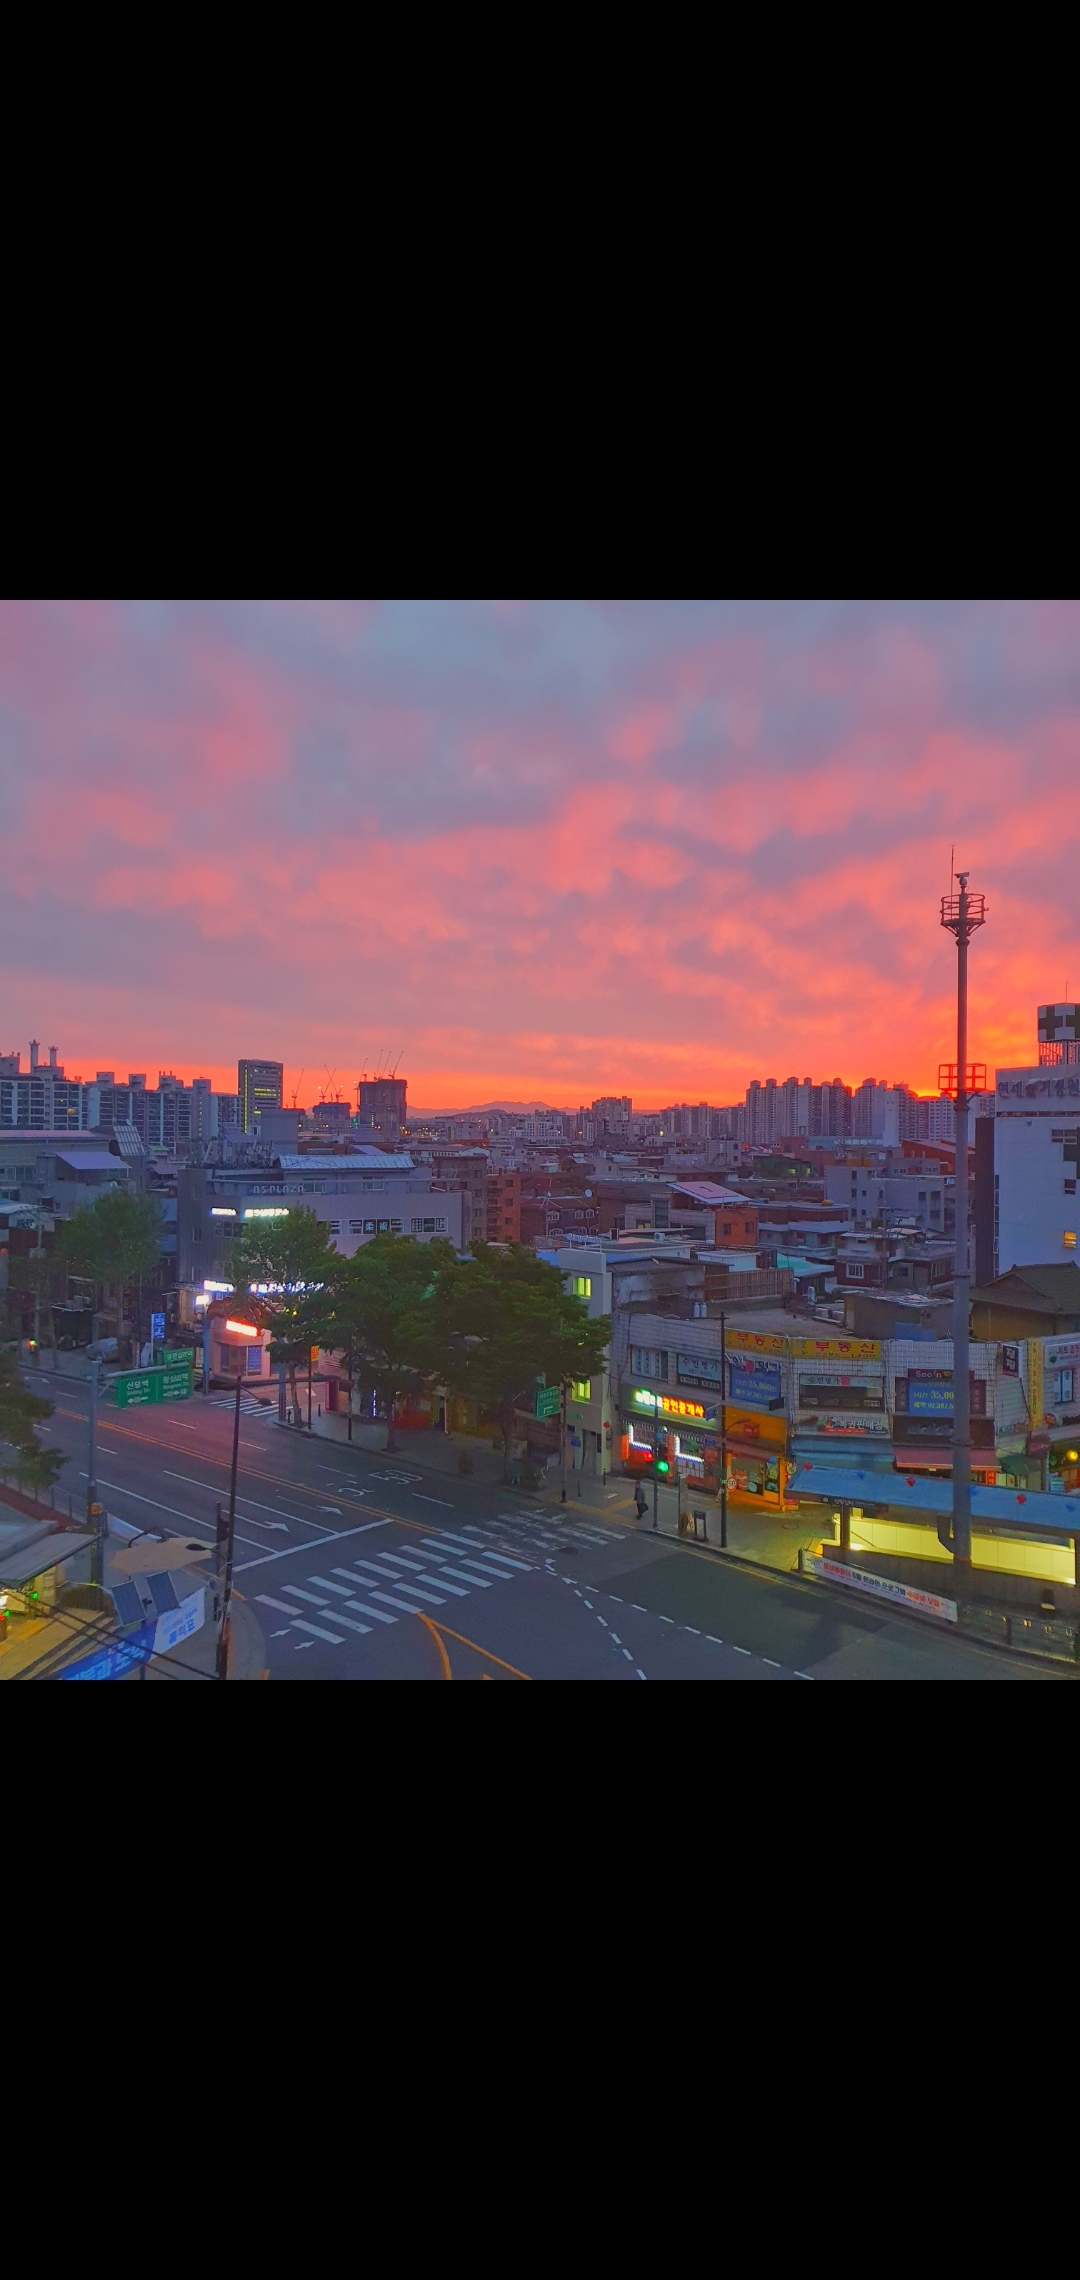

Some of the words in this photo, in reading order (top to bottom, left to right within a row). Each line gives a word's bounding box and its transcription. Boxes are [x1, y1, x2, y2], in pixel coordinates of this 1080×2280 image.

[737, 1332, 784, 1349] 부동산
[815, 1341, 875, 1354] 부동산
[127, 1379, 149, 1390] 신당역
[662, 1396, 704, 1419] 공인중개사
[882, 1581, 906, 1596] 프로그램
